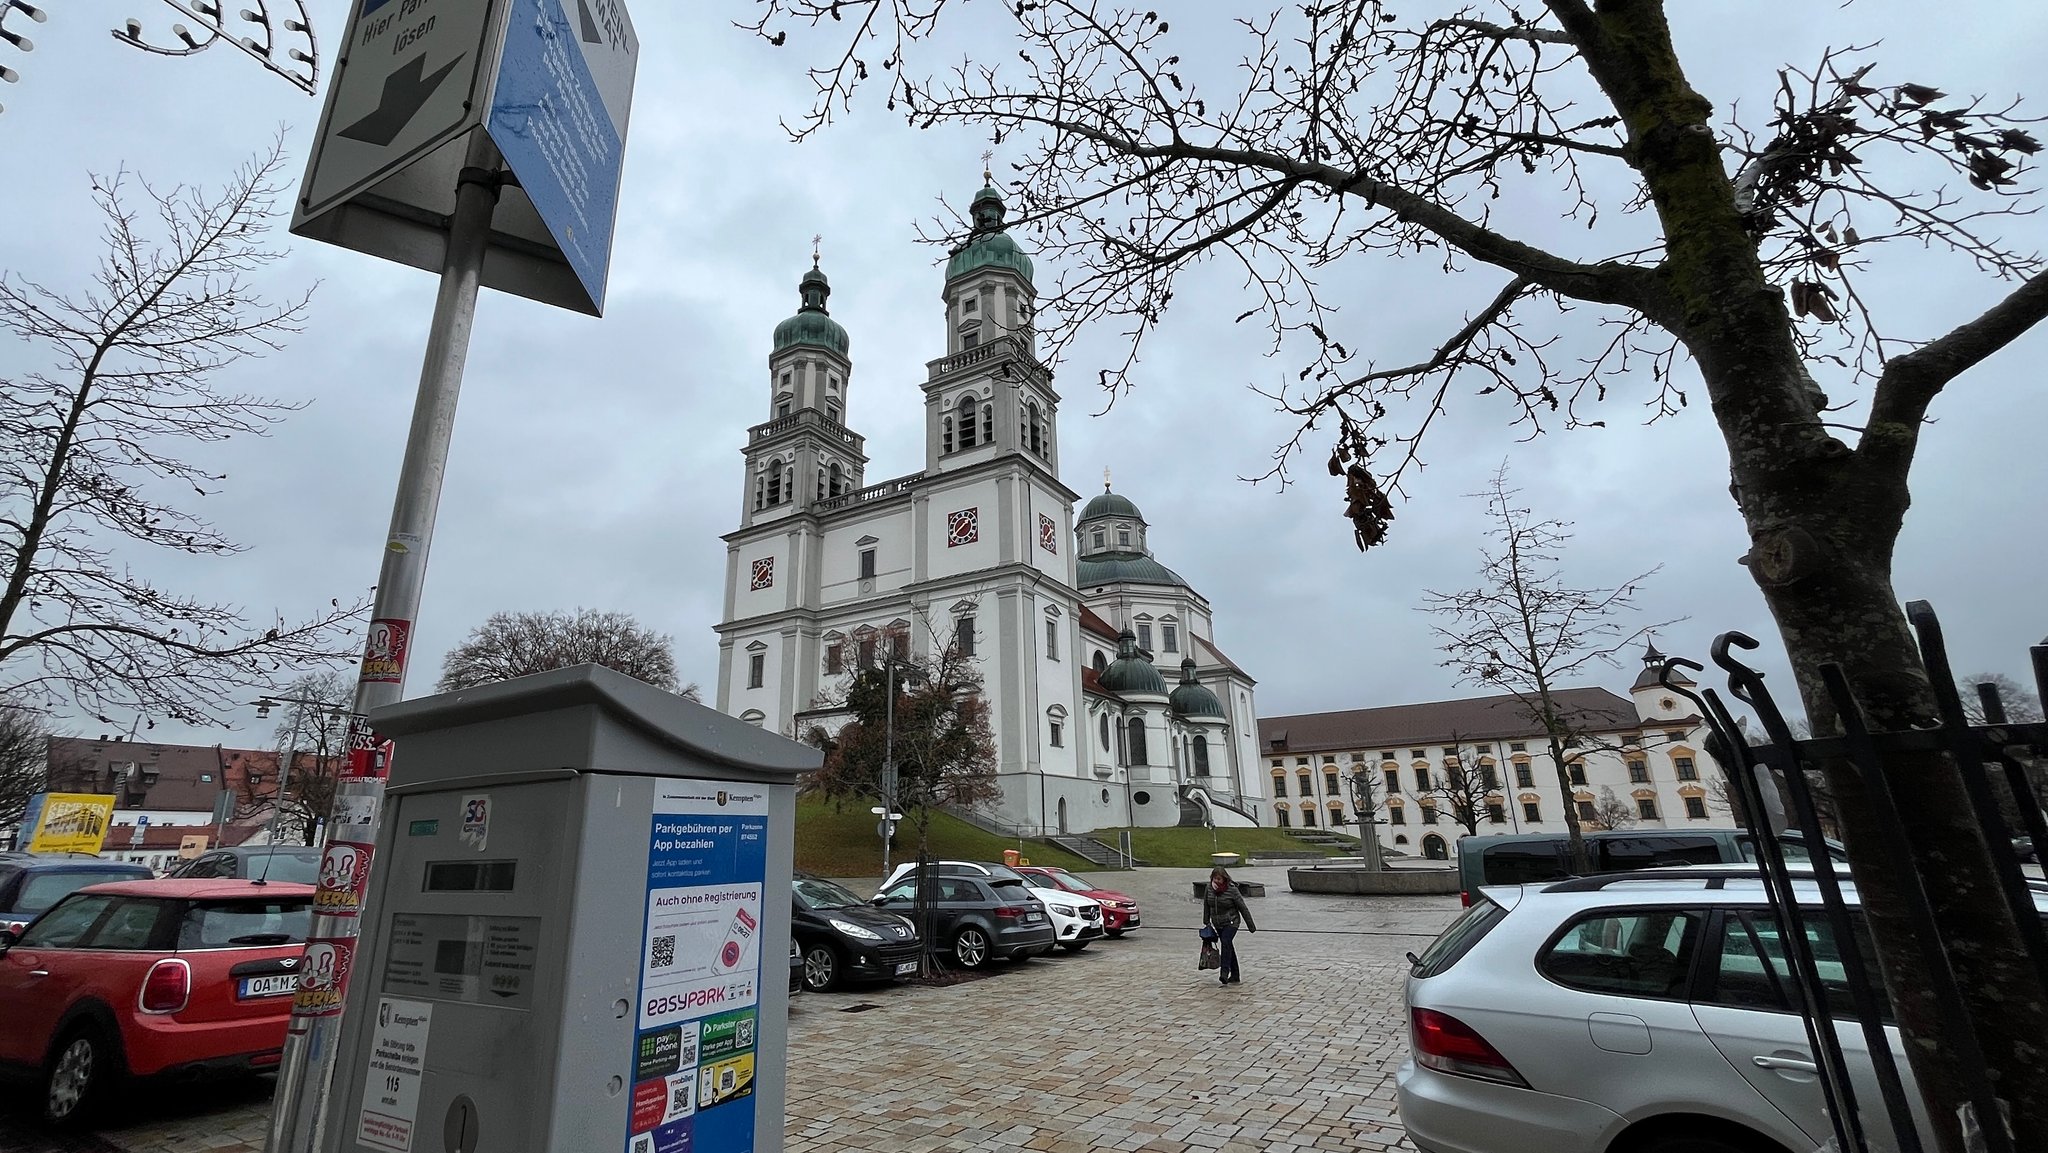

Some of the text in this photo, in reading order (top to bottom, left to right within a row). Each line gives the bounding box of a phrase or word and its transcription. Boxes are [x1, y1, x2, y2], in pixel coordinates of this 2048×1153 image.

[362, 13, 395, 46] Hier
[393, 15, 436, 55] lösen
[542, 50, 556, 80] per
[556, 77, 570, 112] App
[574, 78, 598, 136] Zahlung
[729, 794, 753, 803] Kempten
[655, 823, 732, 835] Parkgebühren per
[654, 840, 714, 852] App bezahlen
[656, 891, 757, 906] Auch ohne Registrierung
[253, 979, 271, 992] OA
[713, 1021, 736, 1032] Parkster
[655, 1042, 678, 1055] phone
[387, 1076, 400, 1092] 115
